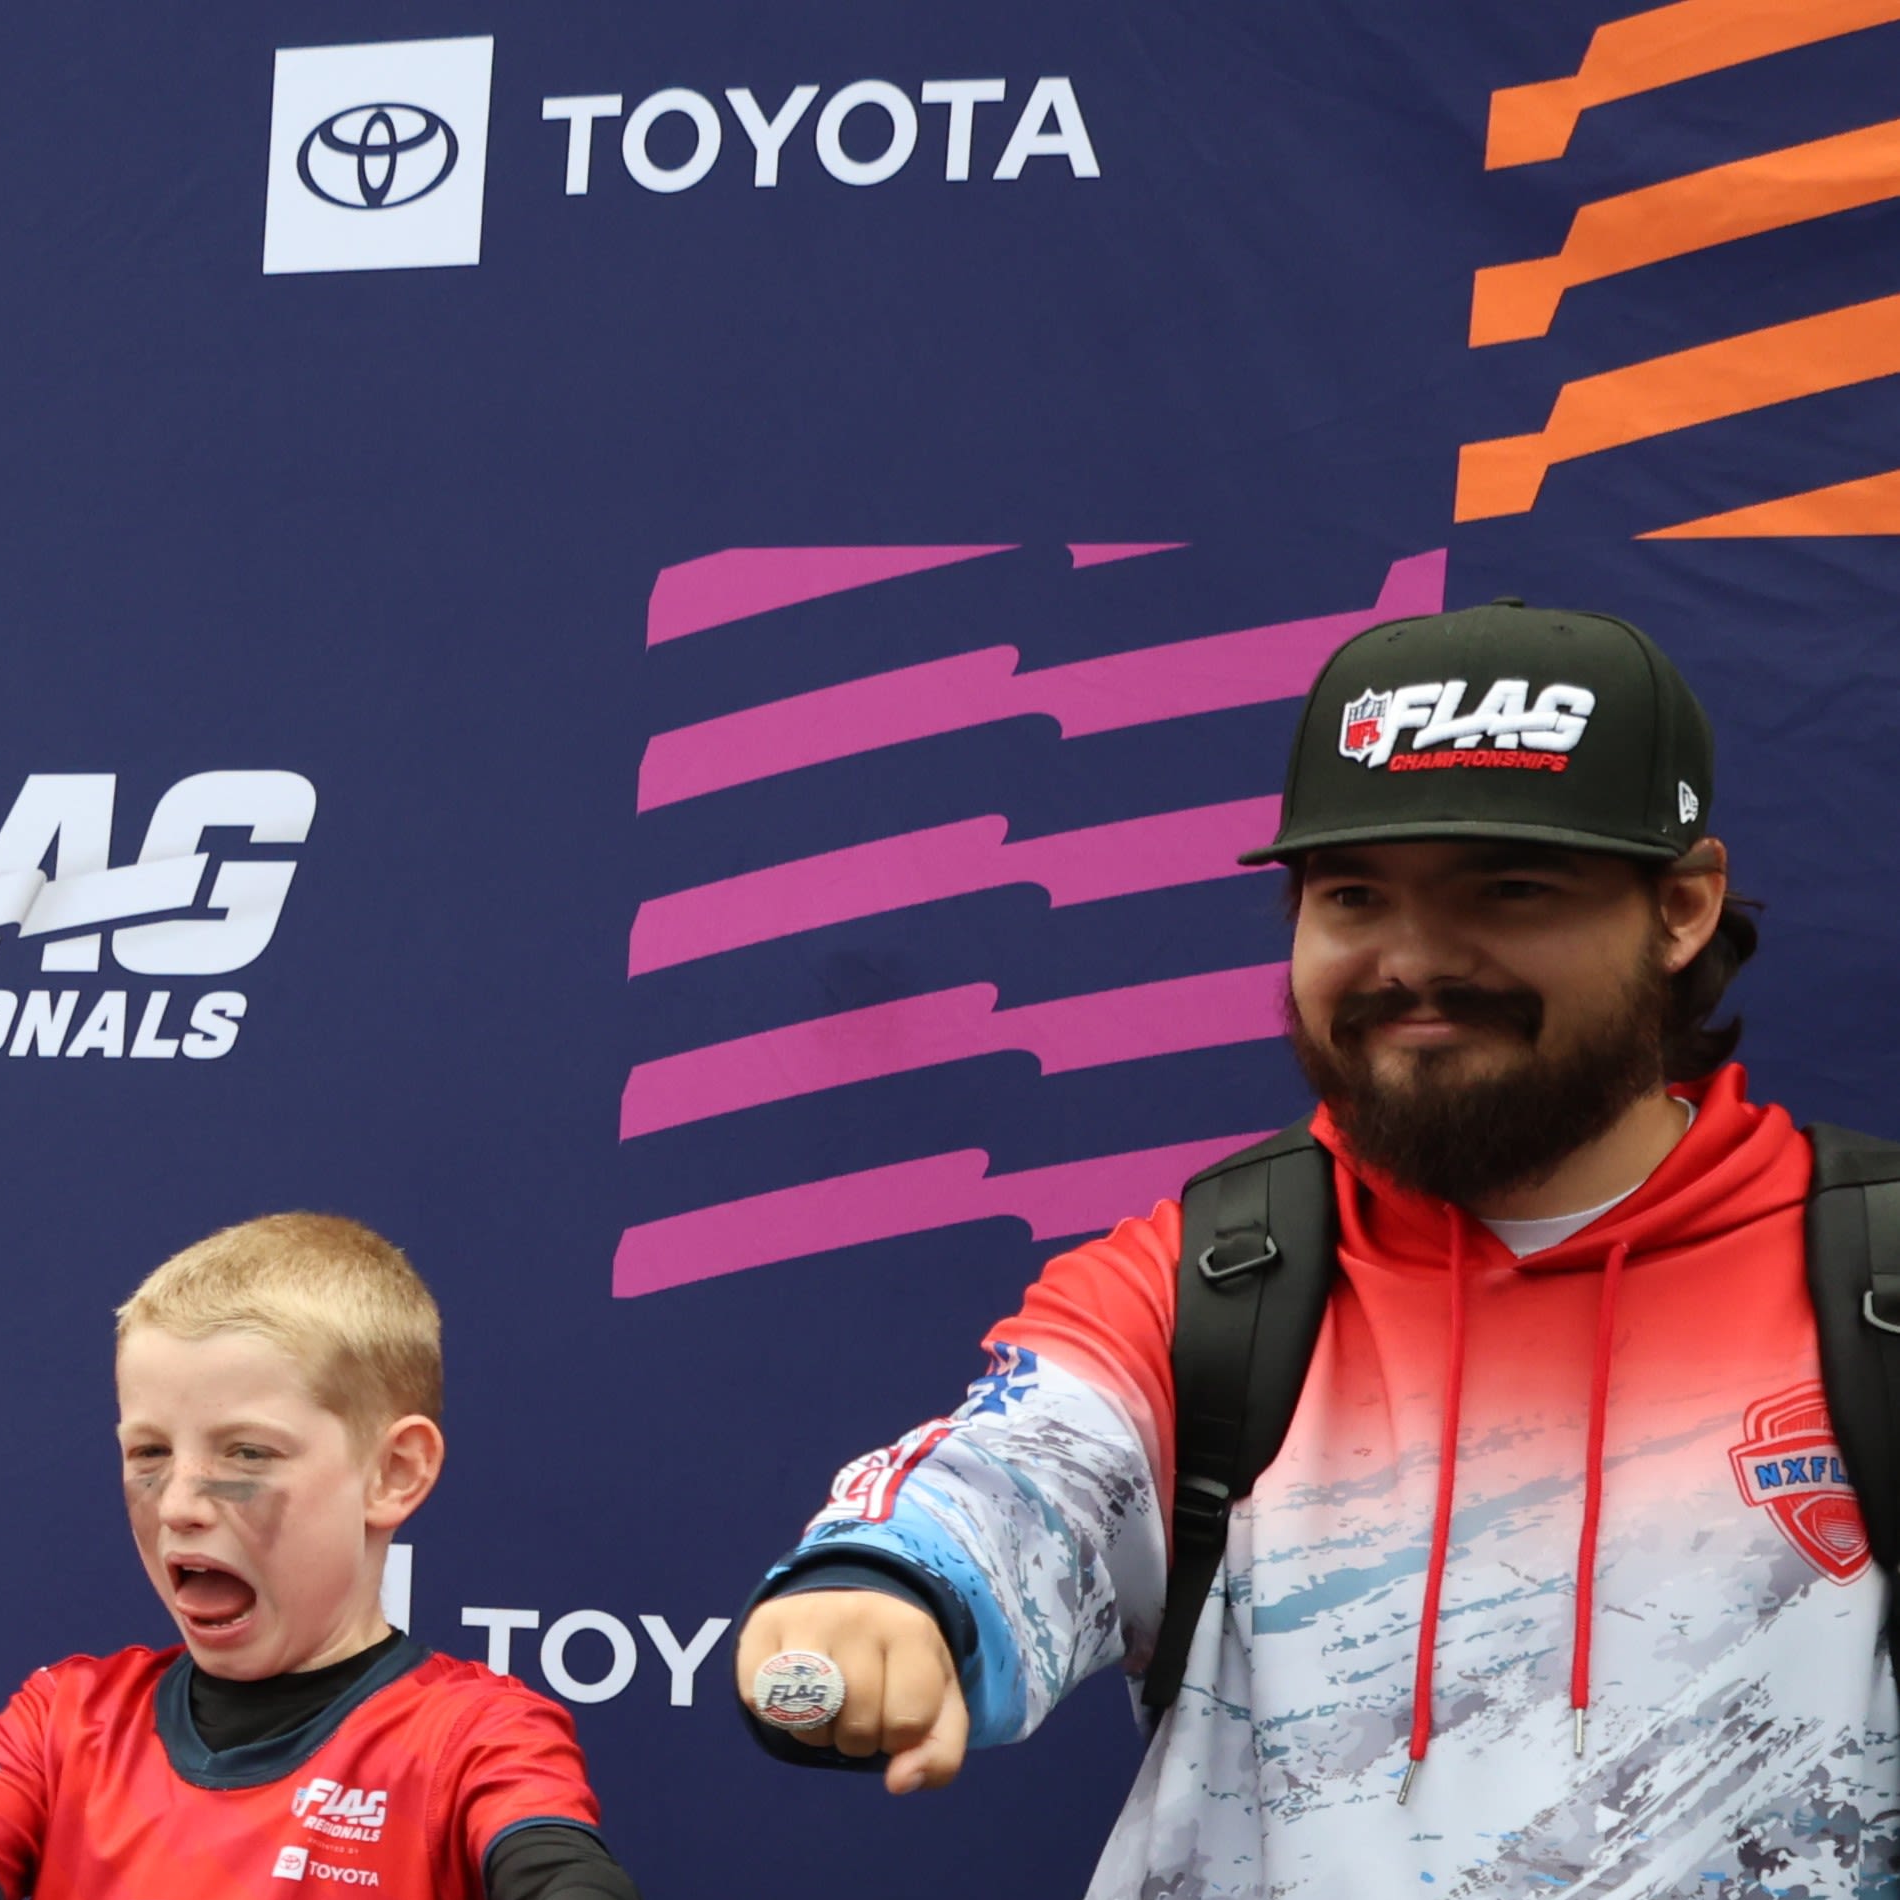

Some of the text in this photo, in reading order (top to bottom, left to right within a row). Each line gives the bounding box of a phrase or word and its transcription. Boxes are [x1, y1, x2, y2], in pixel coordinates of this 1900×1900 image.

[541, 76, 1101, 196] TOYOTA
[1344, 679, 1597, 769] NFL FLAG
[1387, 749, 1571, 774] CHAMPIONSHIPS
[1754, 1455, 1848, 1490] NXFL
[461, 1606, 732, 1707] TOY
[765, 1684, 829, 1707] FLAG
[296, 1777, 388, 1828] FLAG
[303, 1815, 382, 1843] REGIONALS
[309, 1860, 380, 1887] TOYOTA
